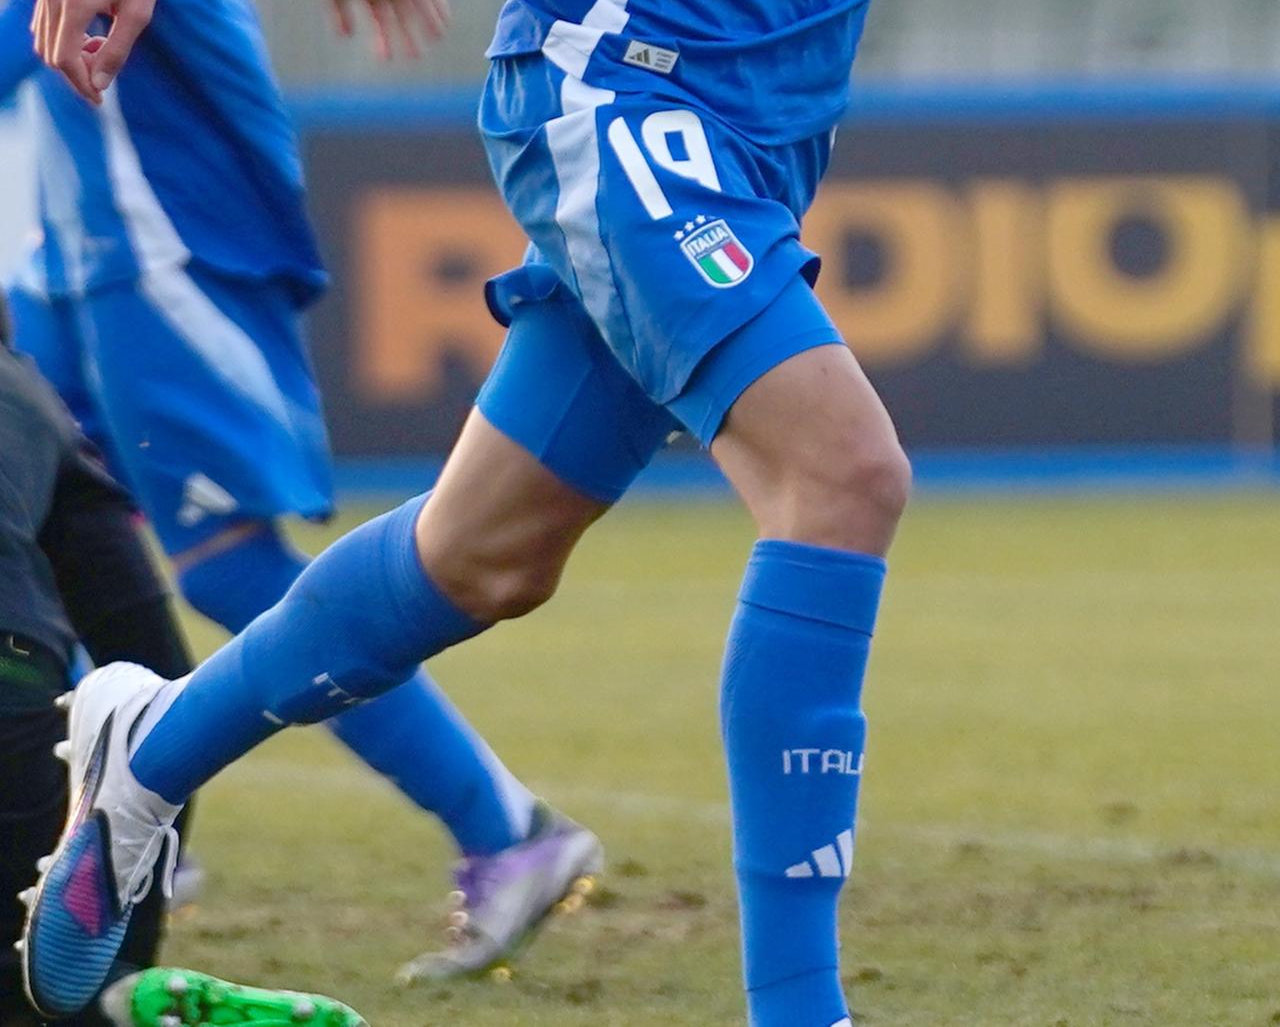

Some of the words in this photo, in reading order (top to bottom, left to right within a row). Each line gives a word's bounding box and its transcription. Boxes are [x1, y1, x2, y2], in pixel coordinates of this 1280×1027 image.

[607, 109, 722, 221] 19
[356, 181, 1250, 396] RDIO
[686, 226, 729, 257] ITALIA
